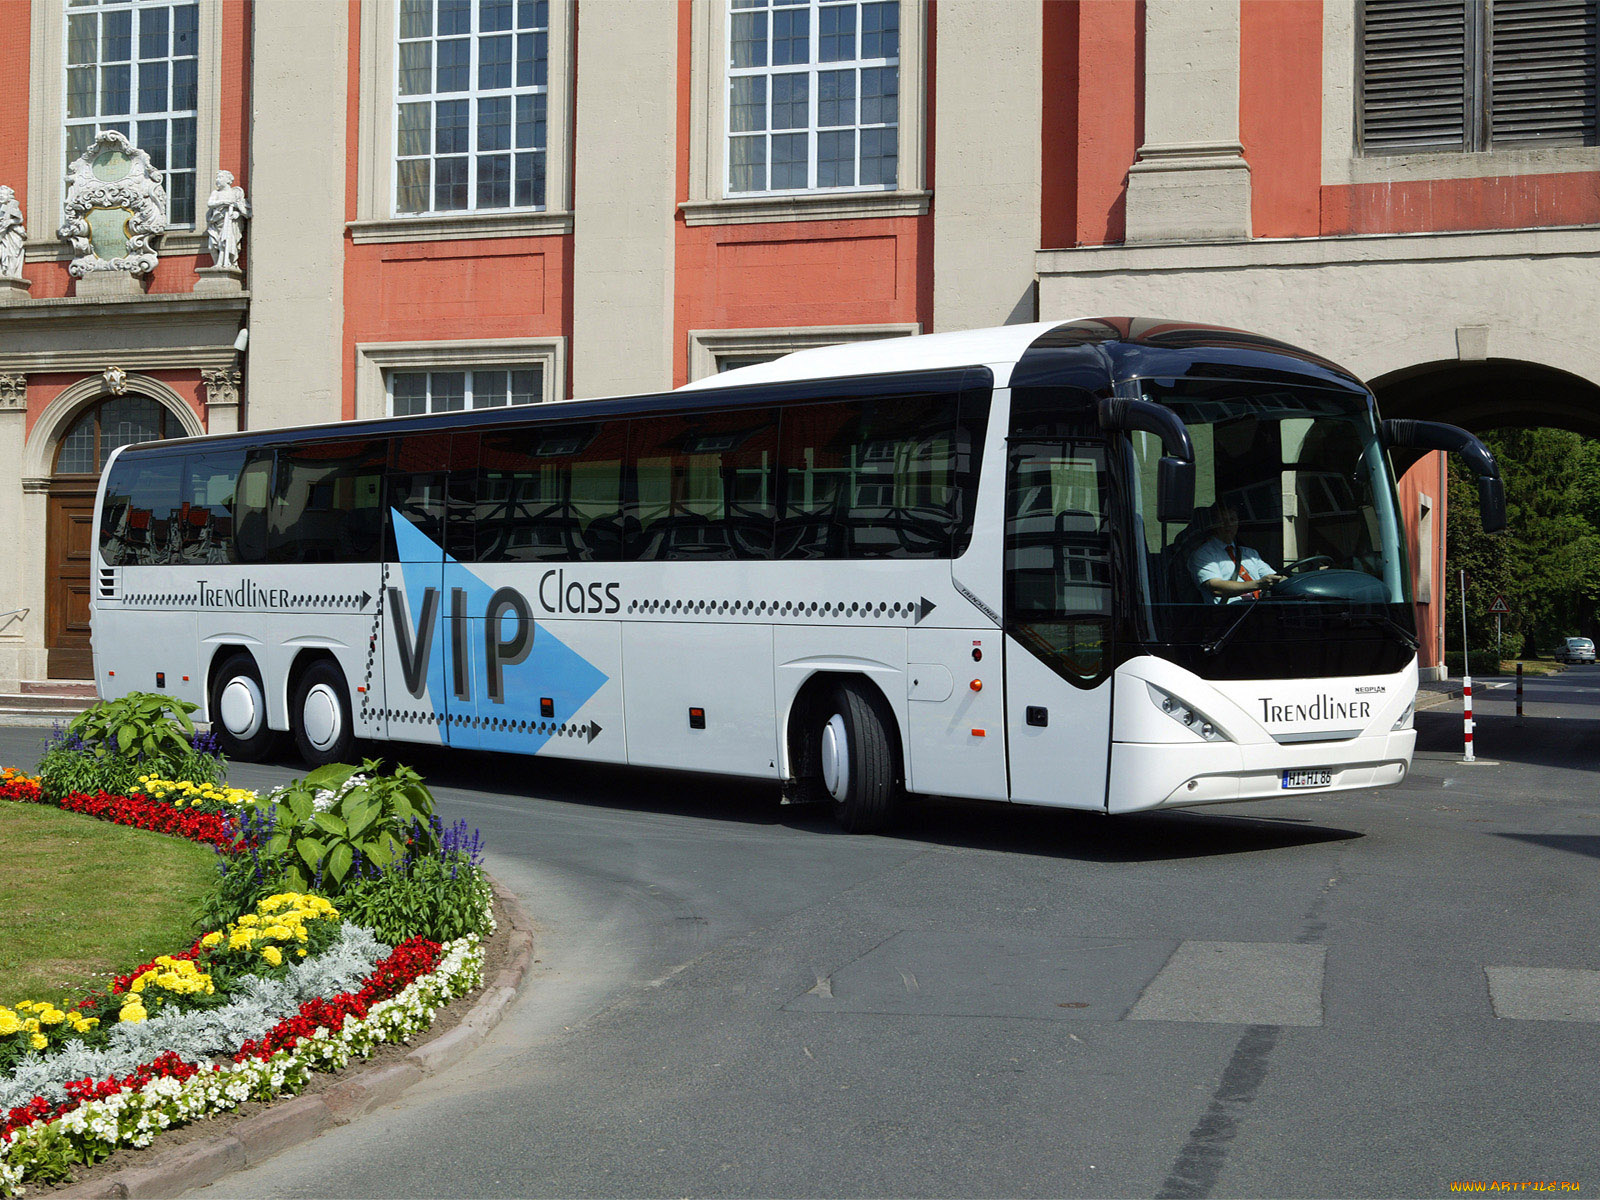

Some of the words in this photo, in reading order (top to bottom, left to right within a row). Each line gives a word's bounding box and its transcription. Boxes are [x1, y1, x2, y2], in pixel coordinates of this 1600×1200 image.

[387, 586, 535, 705] VIP
[539, 568, 621, 614] Class
[1354, 685, 1386, 694] NEOPLAN
[1320, 770, 1331, 784] 86
